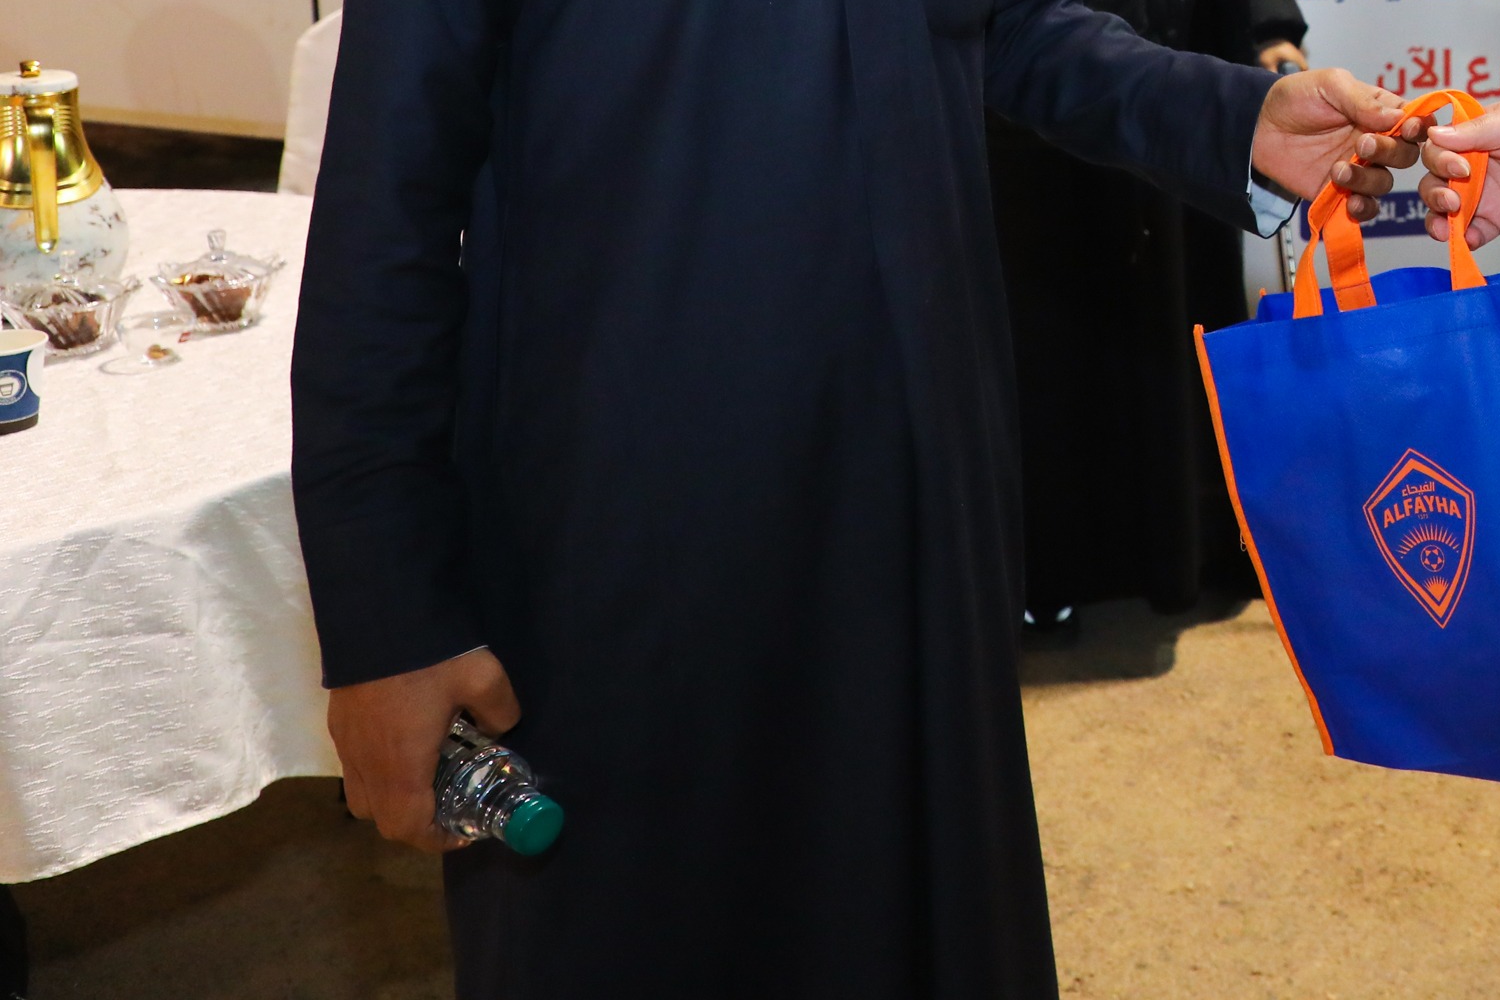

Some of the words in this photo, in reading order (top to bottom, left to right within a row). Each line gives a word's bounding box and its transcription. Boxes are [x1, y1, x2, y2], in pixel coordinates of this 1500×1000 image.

[1376, 46, 1452, 97] الآن
[1401, 481, 1436, 497] الفيحاء
[1383, 495, 1463, 529] ALFAYHA
